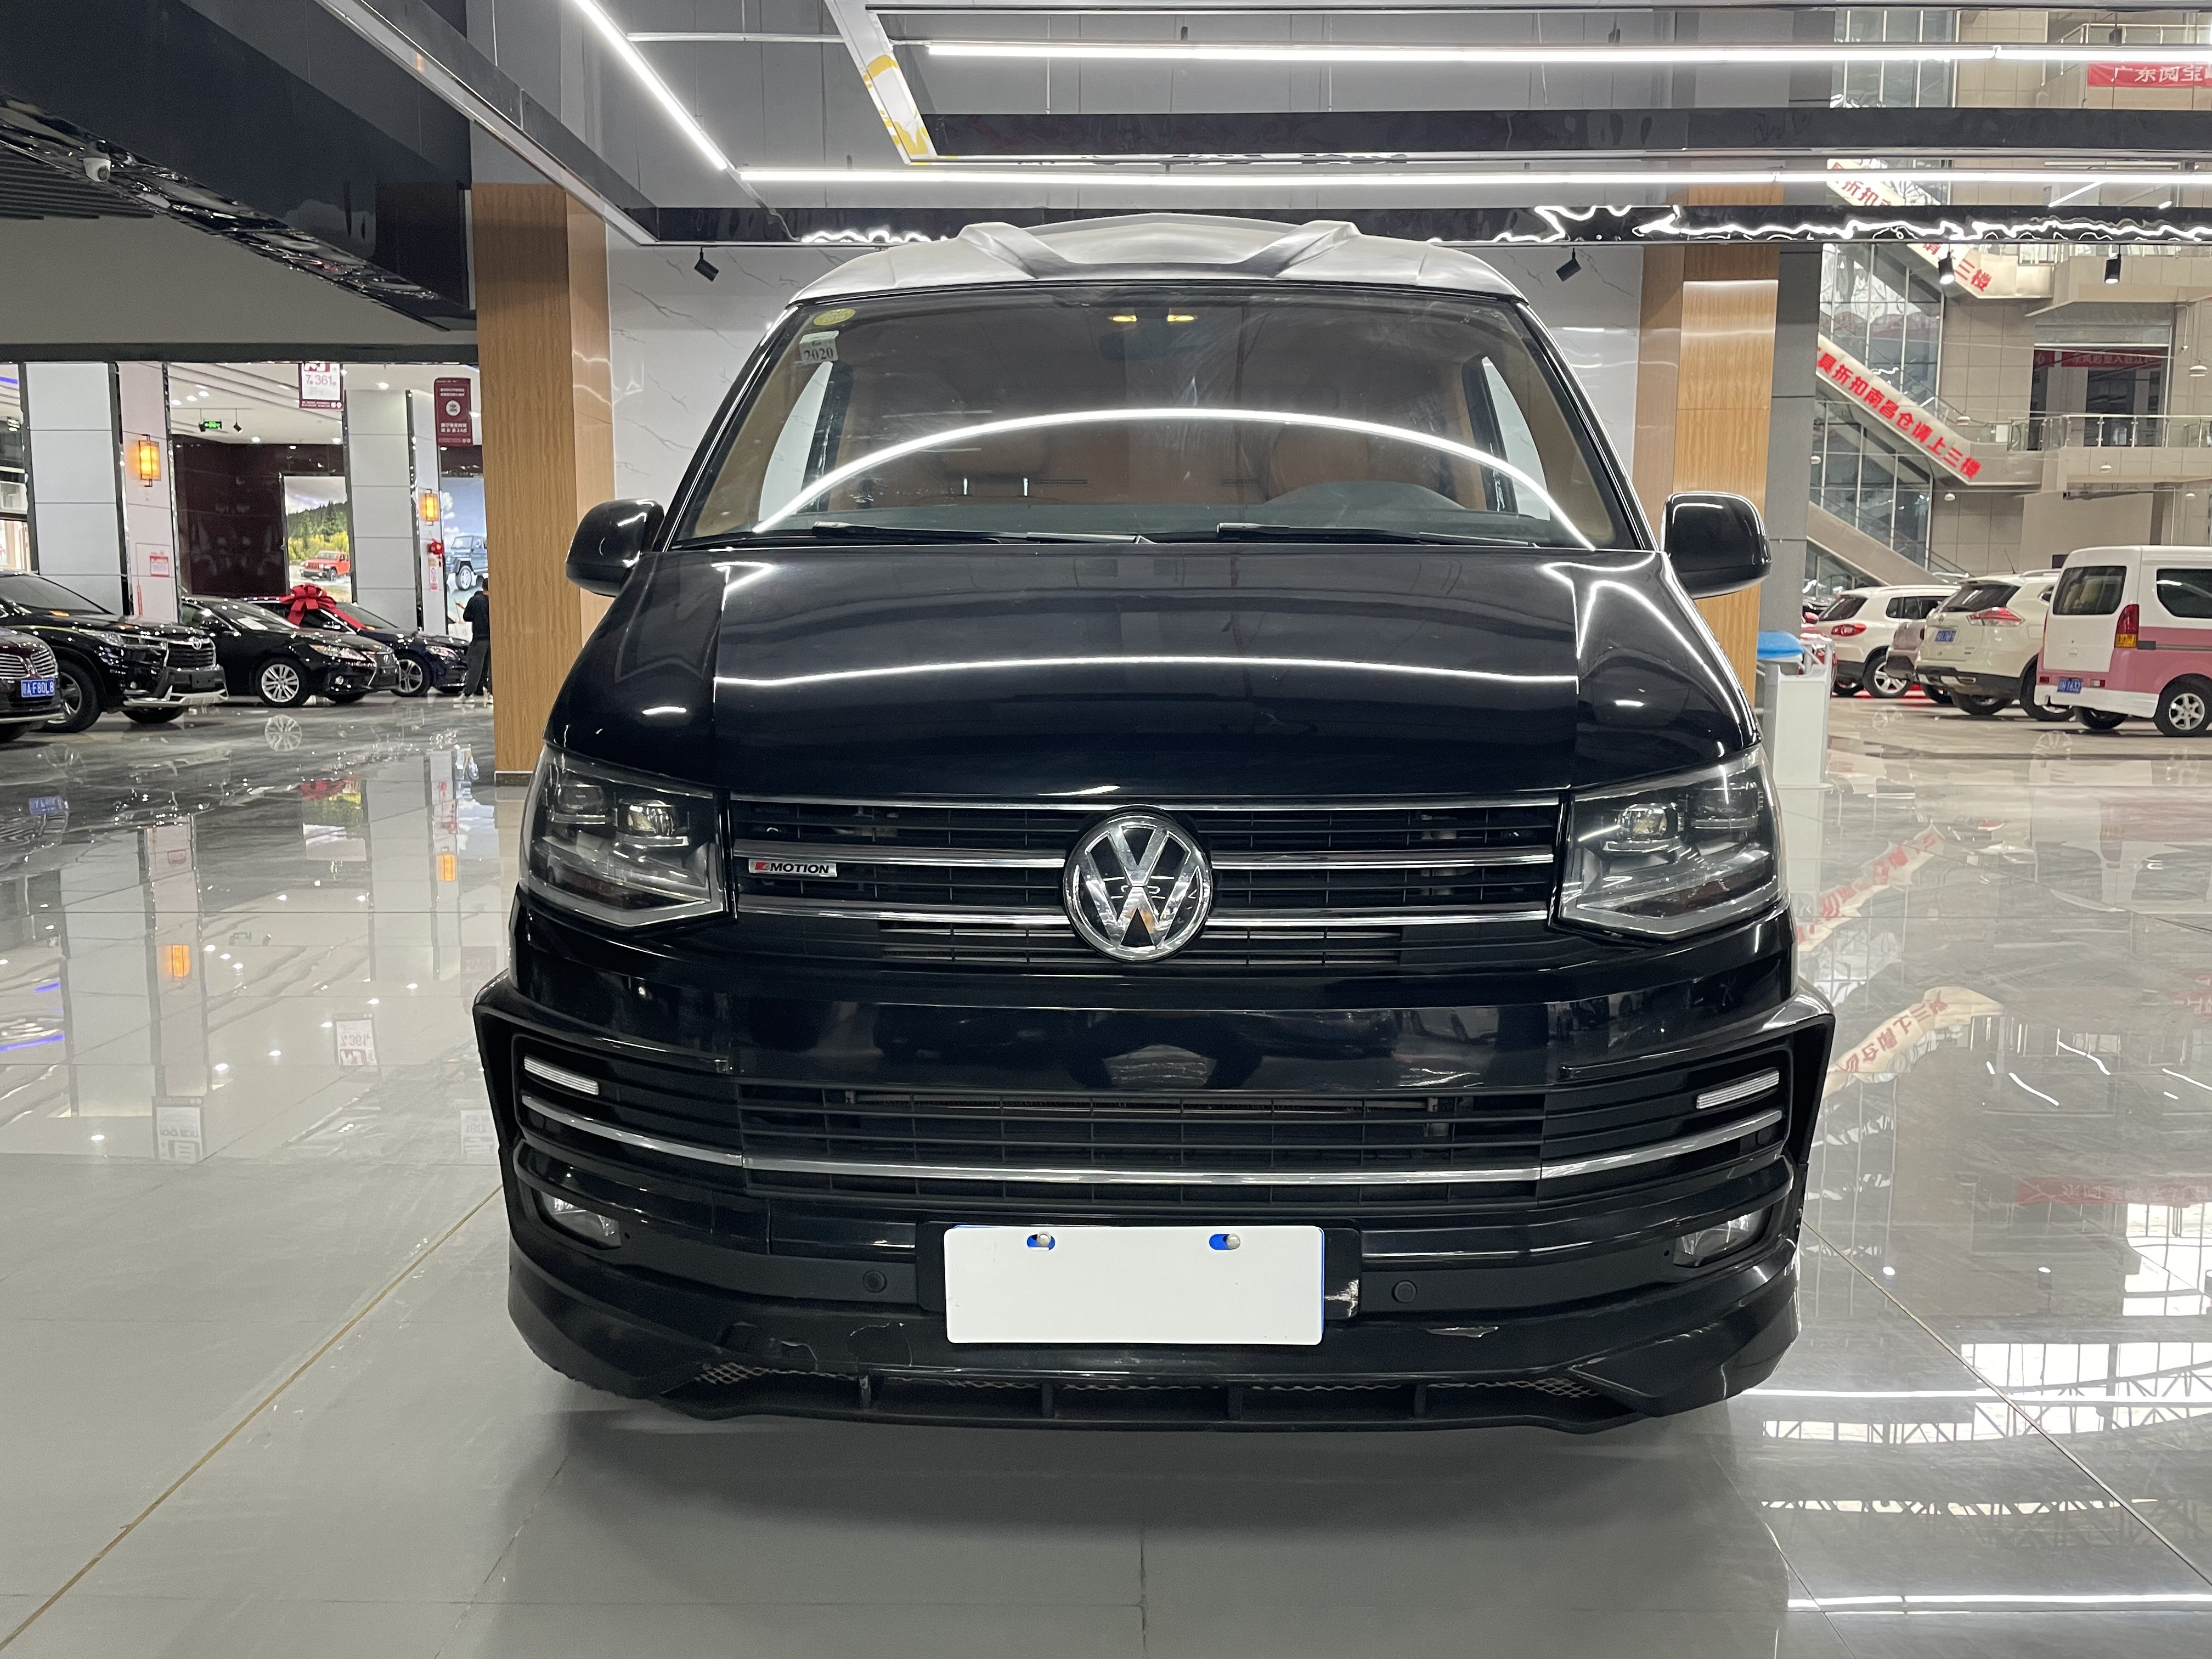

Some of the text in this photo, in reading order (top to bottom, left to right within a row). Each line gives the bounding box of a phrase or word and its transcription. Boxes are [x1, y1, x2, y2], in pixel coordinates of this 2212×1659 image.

[804, 347, 834, 361] 2020
[1817, 346, 1982, 479] 具折扣南昌仓请上三楼
